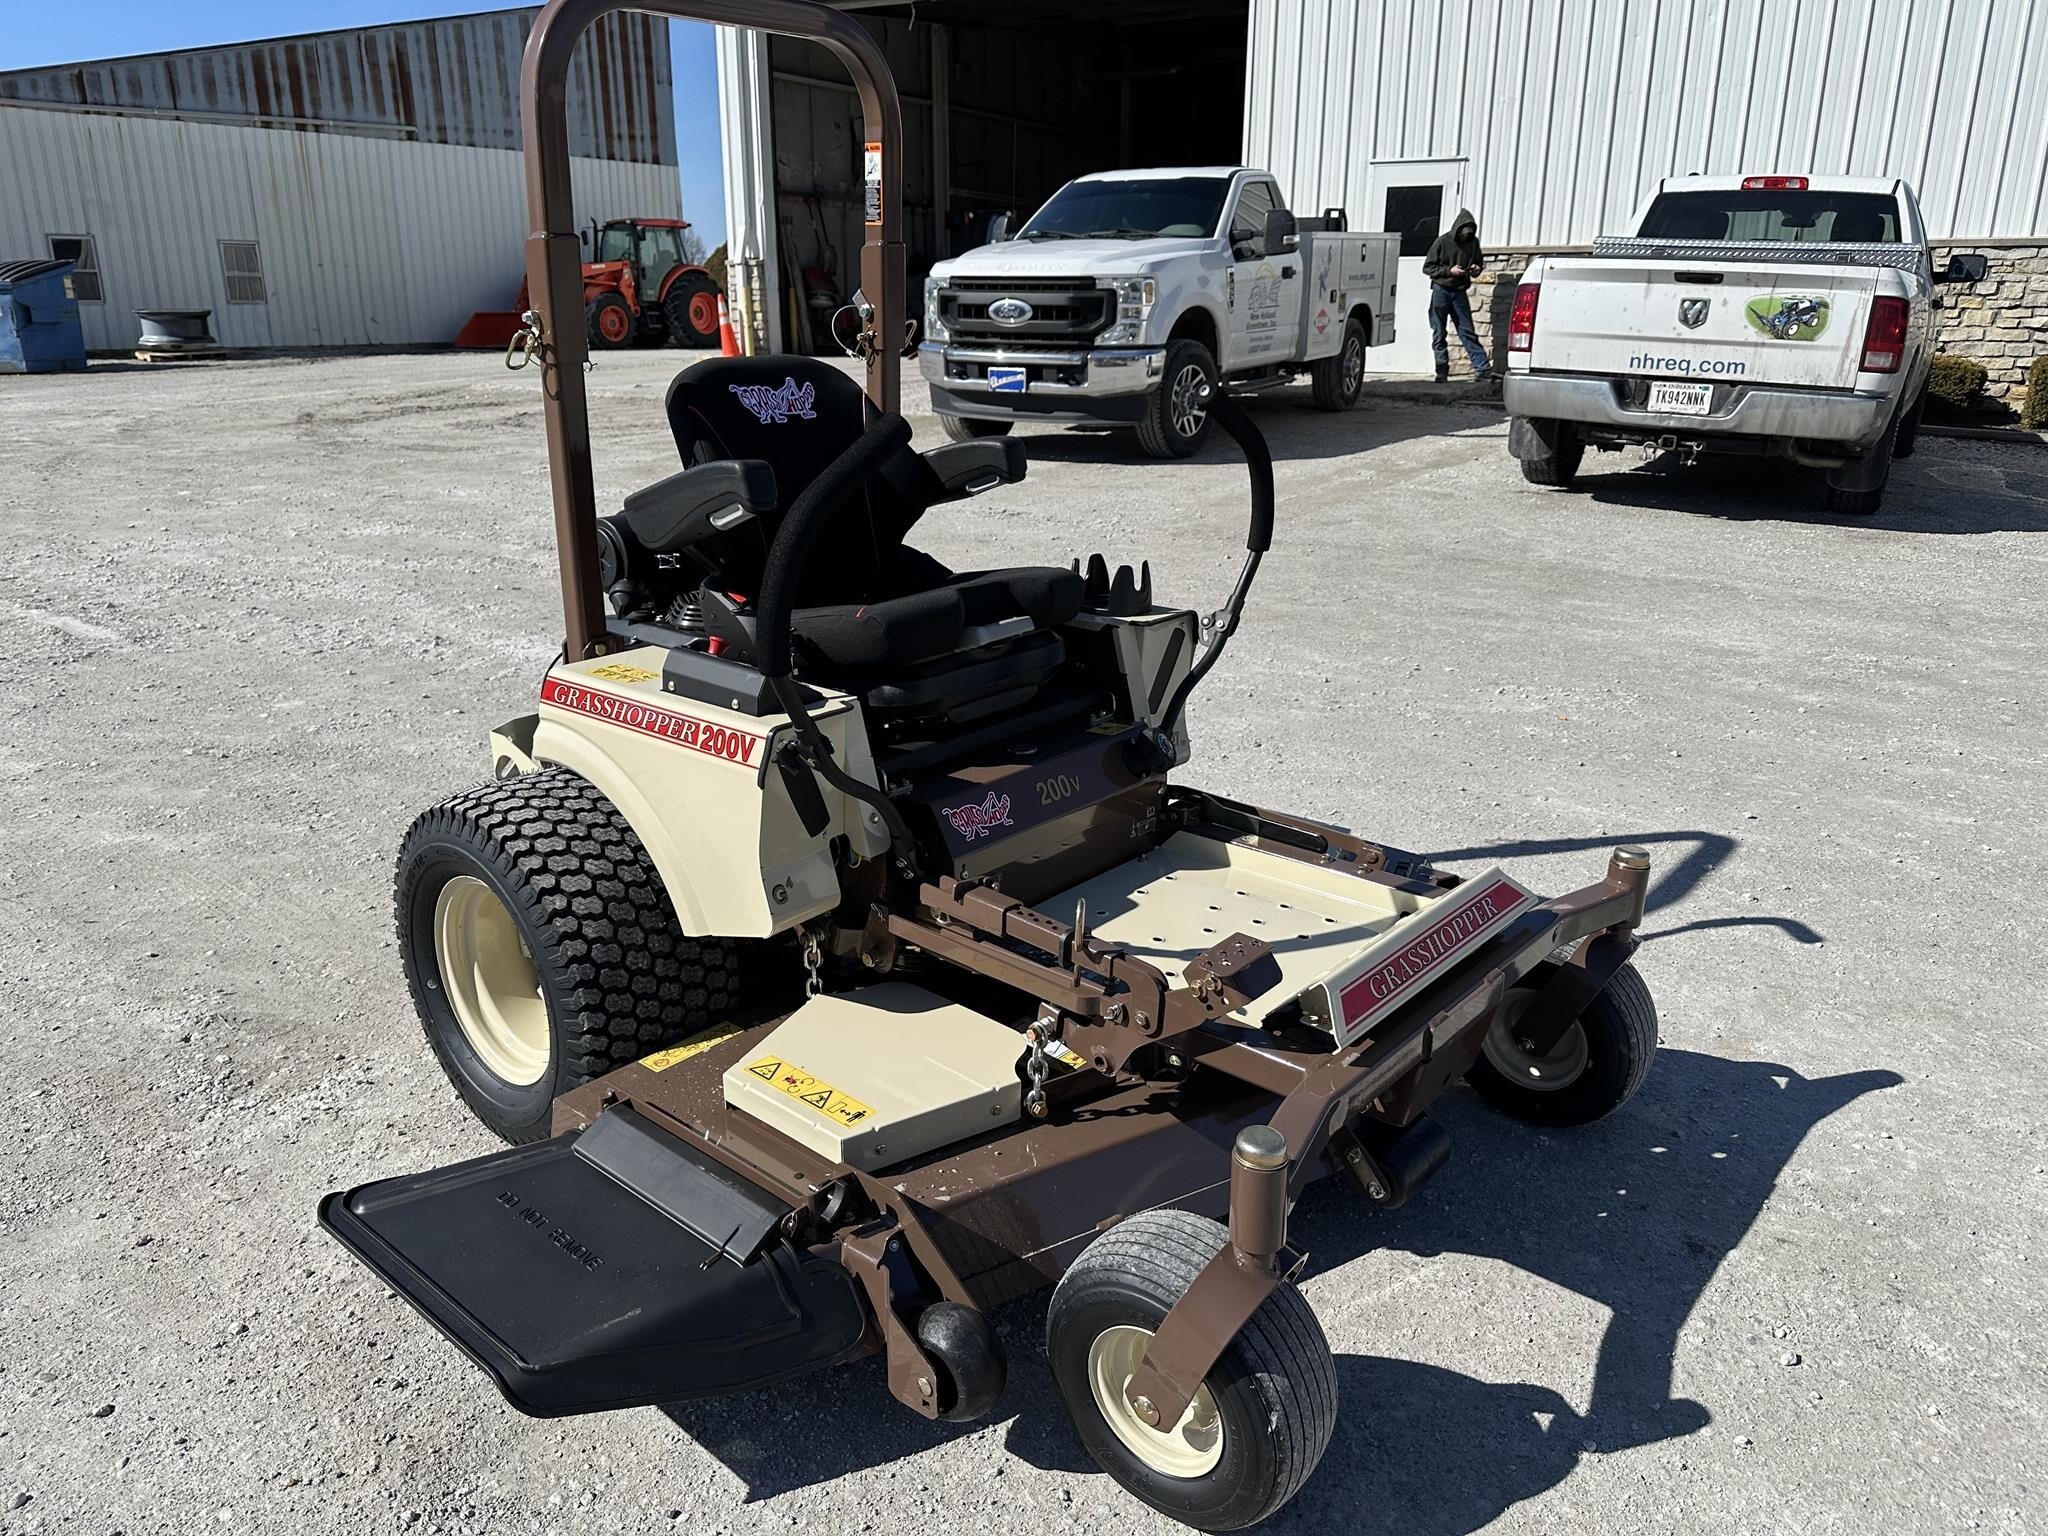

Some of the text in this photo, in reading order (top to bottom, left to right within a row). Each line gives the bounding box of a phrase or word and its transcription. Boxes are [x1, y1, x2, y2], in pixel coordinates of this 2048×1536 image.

[1629, 353, 1746, 375] nhreq.com
[1656, 390, 1706, 406] TK942NNK
[554, 685, 757, 763] GRASSHOPPER 200V
[1369, 897, 1499, 999] GRASSHOPPER
[495, 1190, 606, 1272] DO NOT REMOVE
